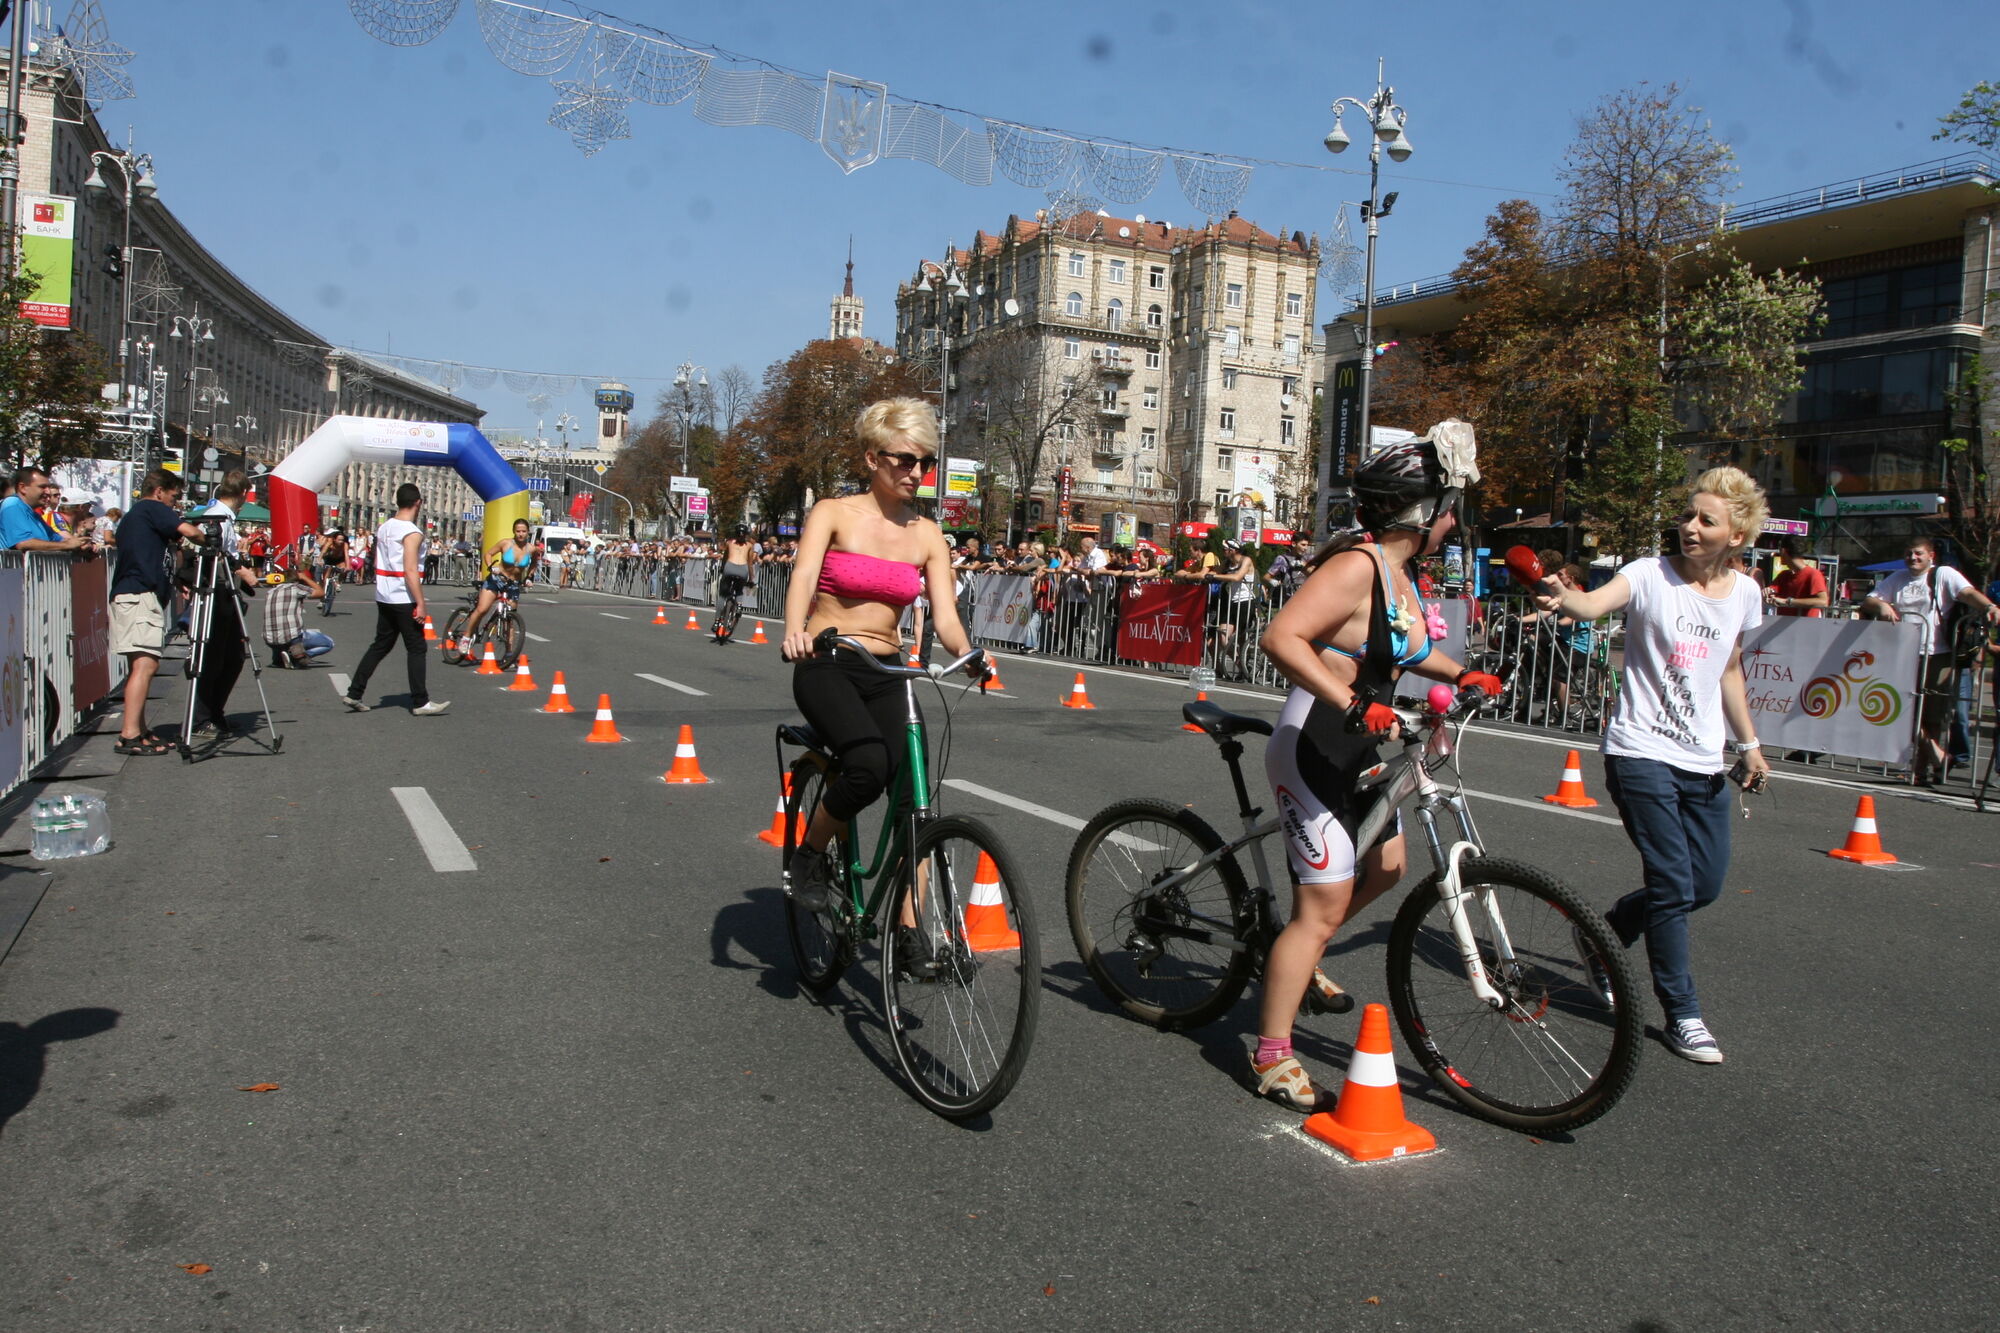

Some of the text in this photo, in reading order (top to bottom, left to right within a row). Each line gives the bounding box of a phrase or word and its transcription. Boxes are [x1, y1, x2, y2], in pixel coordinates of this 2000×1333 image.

[36, 207, 63, 218] БТА
[36, 225, 61, 234] БАНК
[1337, 398, 1348, 476] McDonald's
[1676, 615, 1720, 640] Come
[1673, 640, 1709, 660] with
[1660, 681, 1697, 706] away
[1656, 709, 1689, 731] this
[1287, 808, 1322, 859] Radsport
